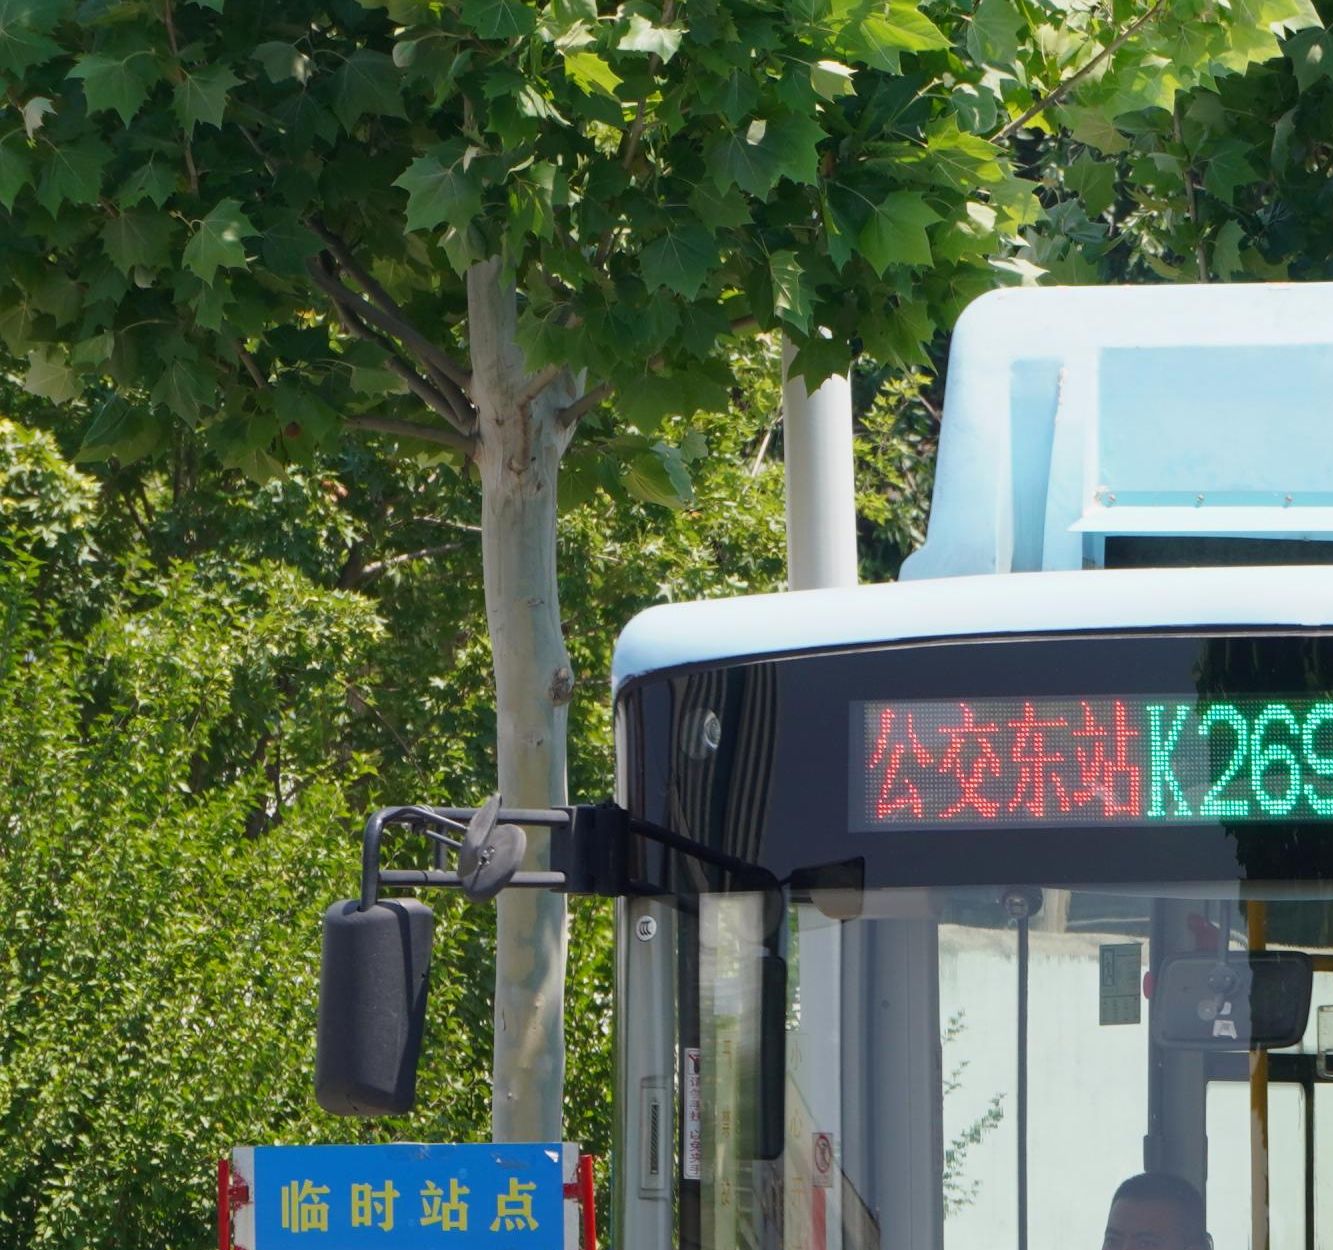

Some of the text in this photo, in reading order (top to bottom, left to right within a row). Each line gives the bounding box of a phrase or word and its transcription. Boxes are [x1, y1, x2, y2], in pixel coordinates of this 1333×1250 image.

[868, 699, 1141, 818] 公交东站
[280, 1177, 540, 1233] 临时站点
